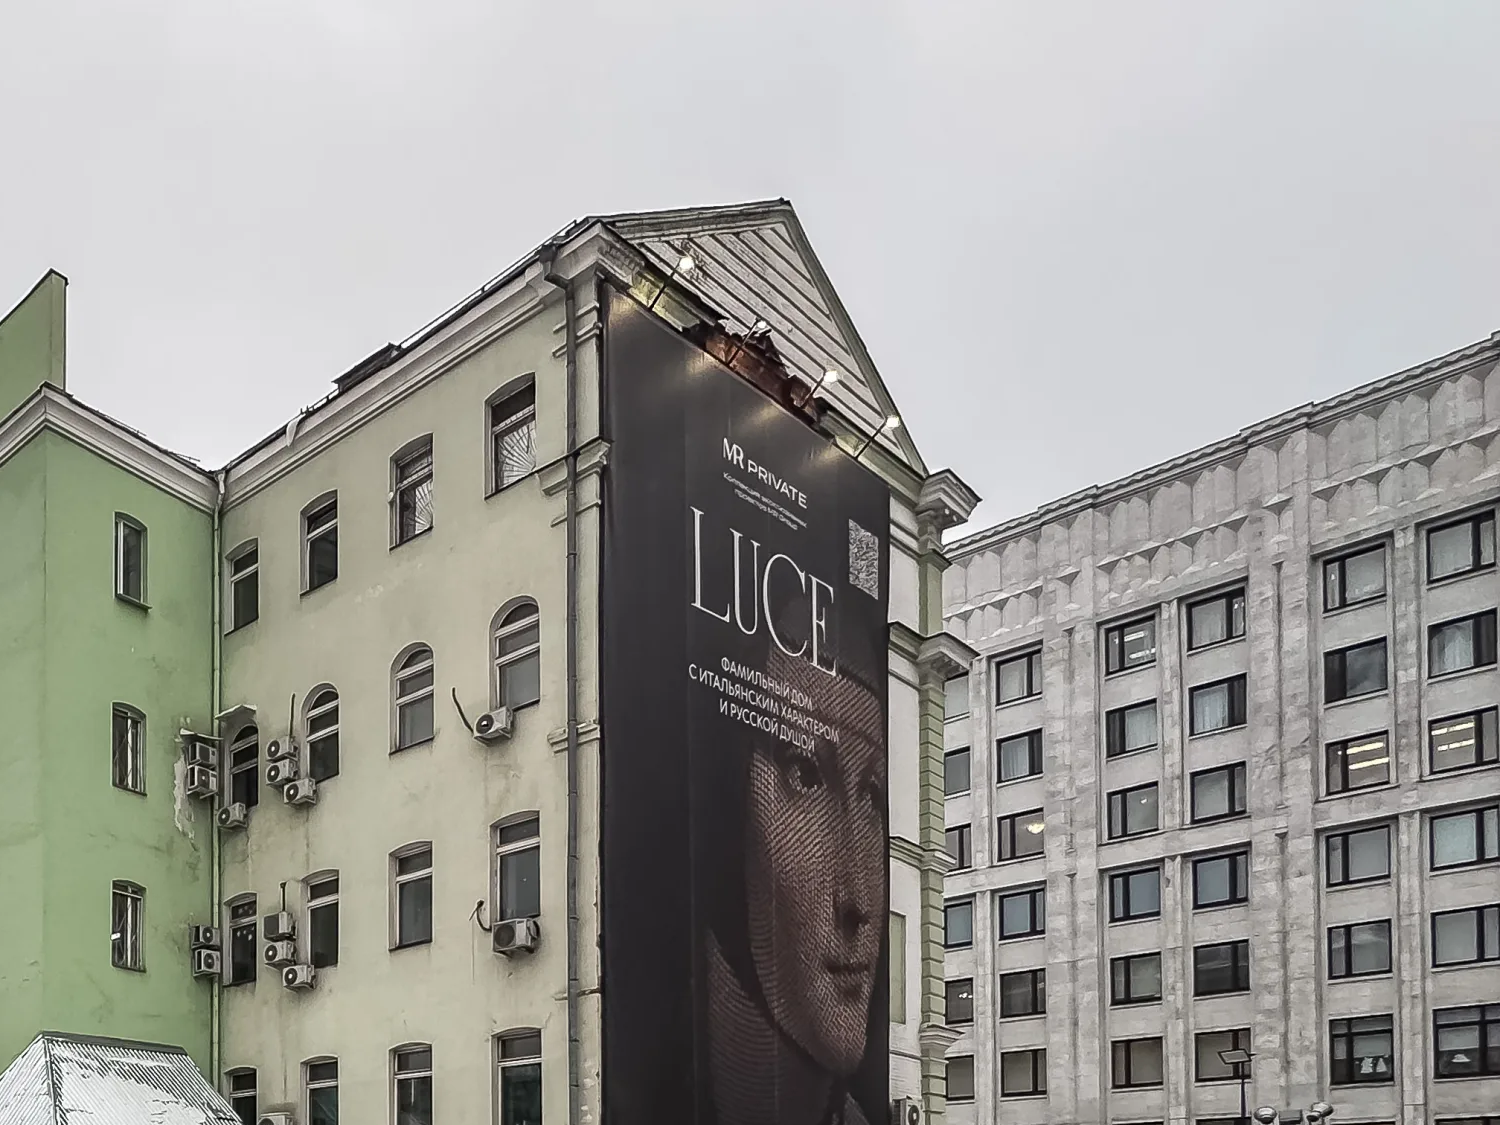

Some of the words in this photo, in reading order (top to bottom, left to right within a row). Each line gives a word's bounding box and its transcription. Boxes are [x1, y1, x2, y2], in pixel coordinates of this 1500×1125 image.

[723, 437, 744, 469] MR
[747, 459, 808, 509] PRIVATE
[690, 505, 837, 677] LUCE
[688, 663, 698, 680] С
[699, 668, 780, 716] ИТАЛЬЯНСКИМ
[780, 702, 840, 743] ХАРАКТЕРОМ
[721, 656, 790, 700] ФАМИЛЬНЫЙ
[791, 688, 813, 712] ДОМ
[719, 698, 728, 716] И
[730, 703, 779, 737] РУССКОЙ
[779, 724, 815, 753] ДУШОЙ
